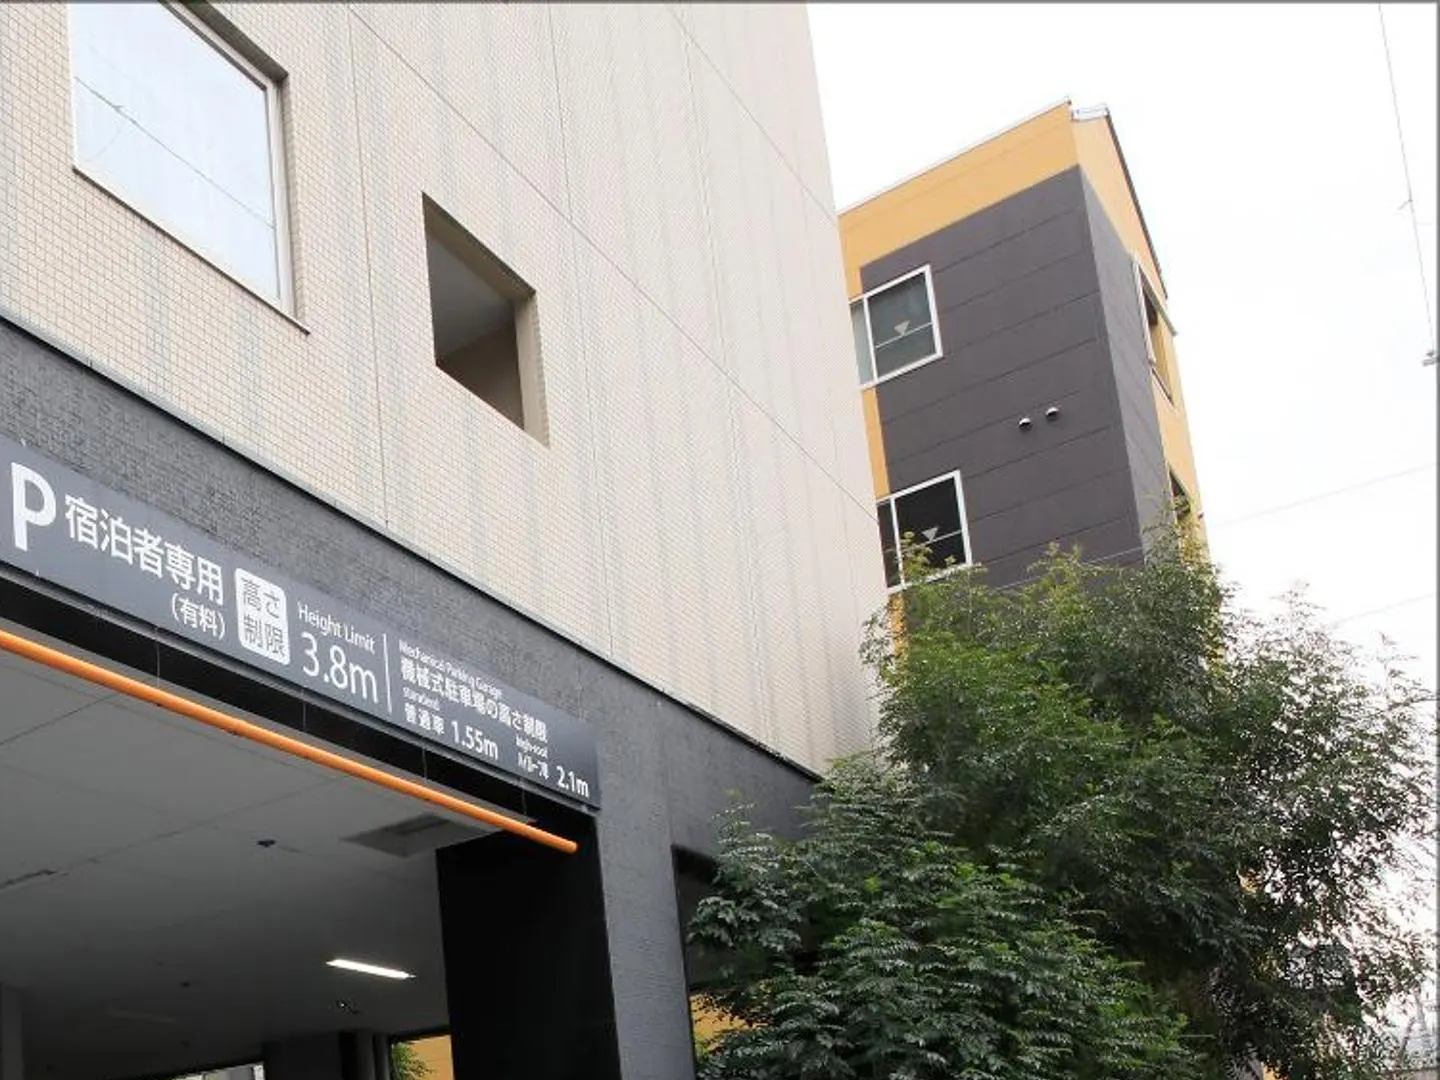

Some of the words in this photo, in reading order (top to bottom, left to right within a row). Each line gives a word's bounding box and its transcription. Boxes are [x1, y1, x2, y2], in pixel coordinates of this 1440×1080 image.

[11, 461, 57, 552] P
[64, 493, 224, 606] 宿泊者専用
[171, 592, 226, 641] (有料)
[297, 602, 343, 640] Height
[344, 622, 376, 655] Limit
[301, 632, 379, 704] 3.8m
[400, 656, 548, 744] 機械式駐車場の高さ制限
[404, 702, 445, 736] 普通車
[451, 720, 499, 761] 1.55m
[556, 765, 590, 798] 2.1m
